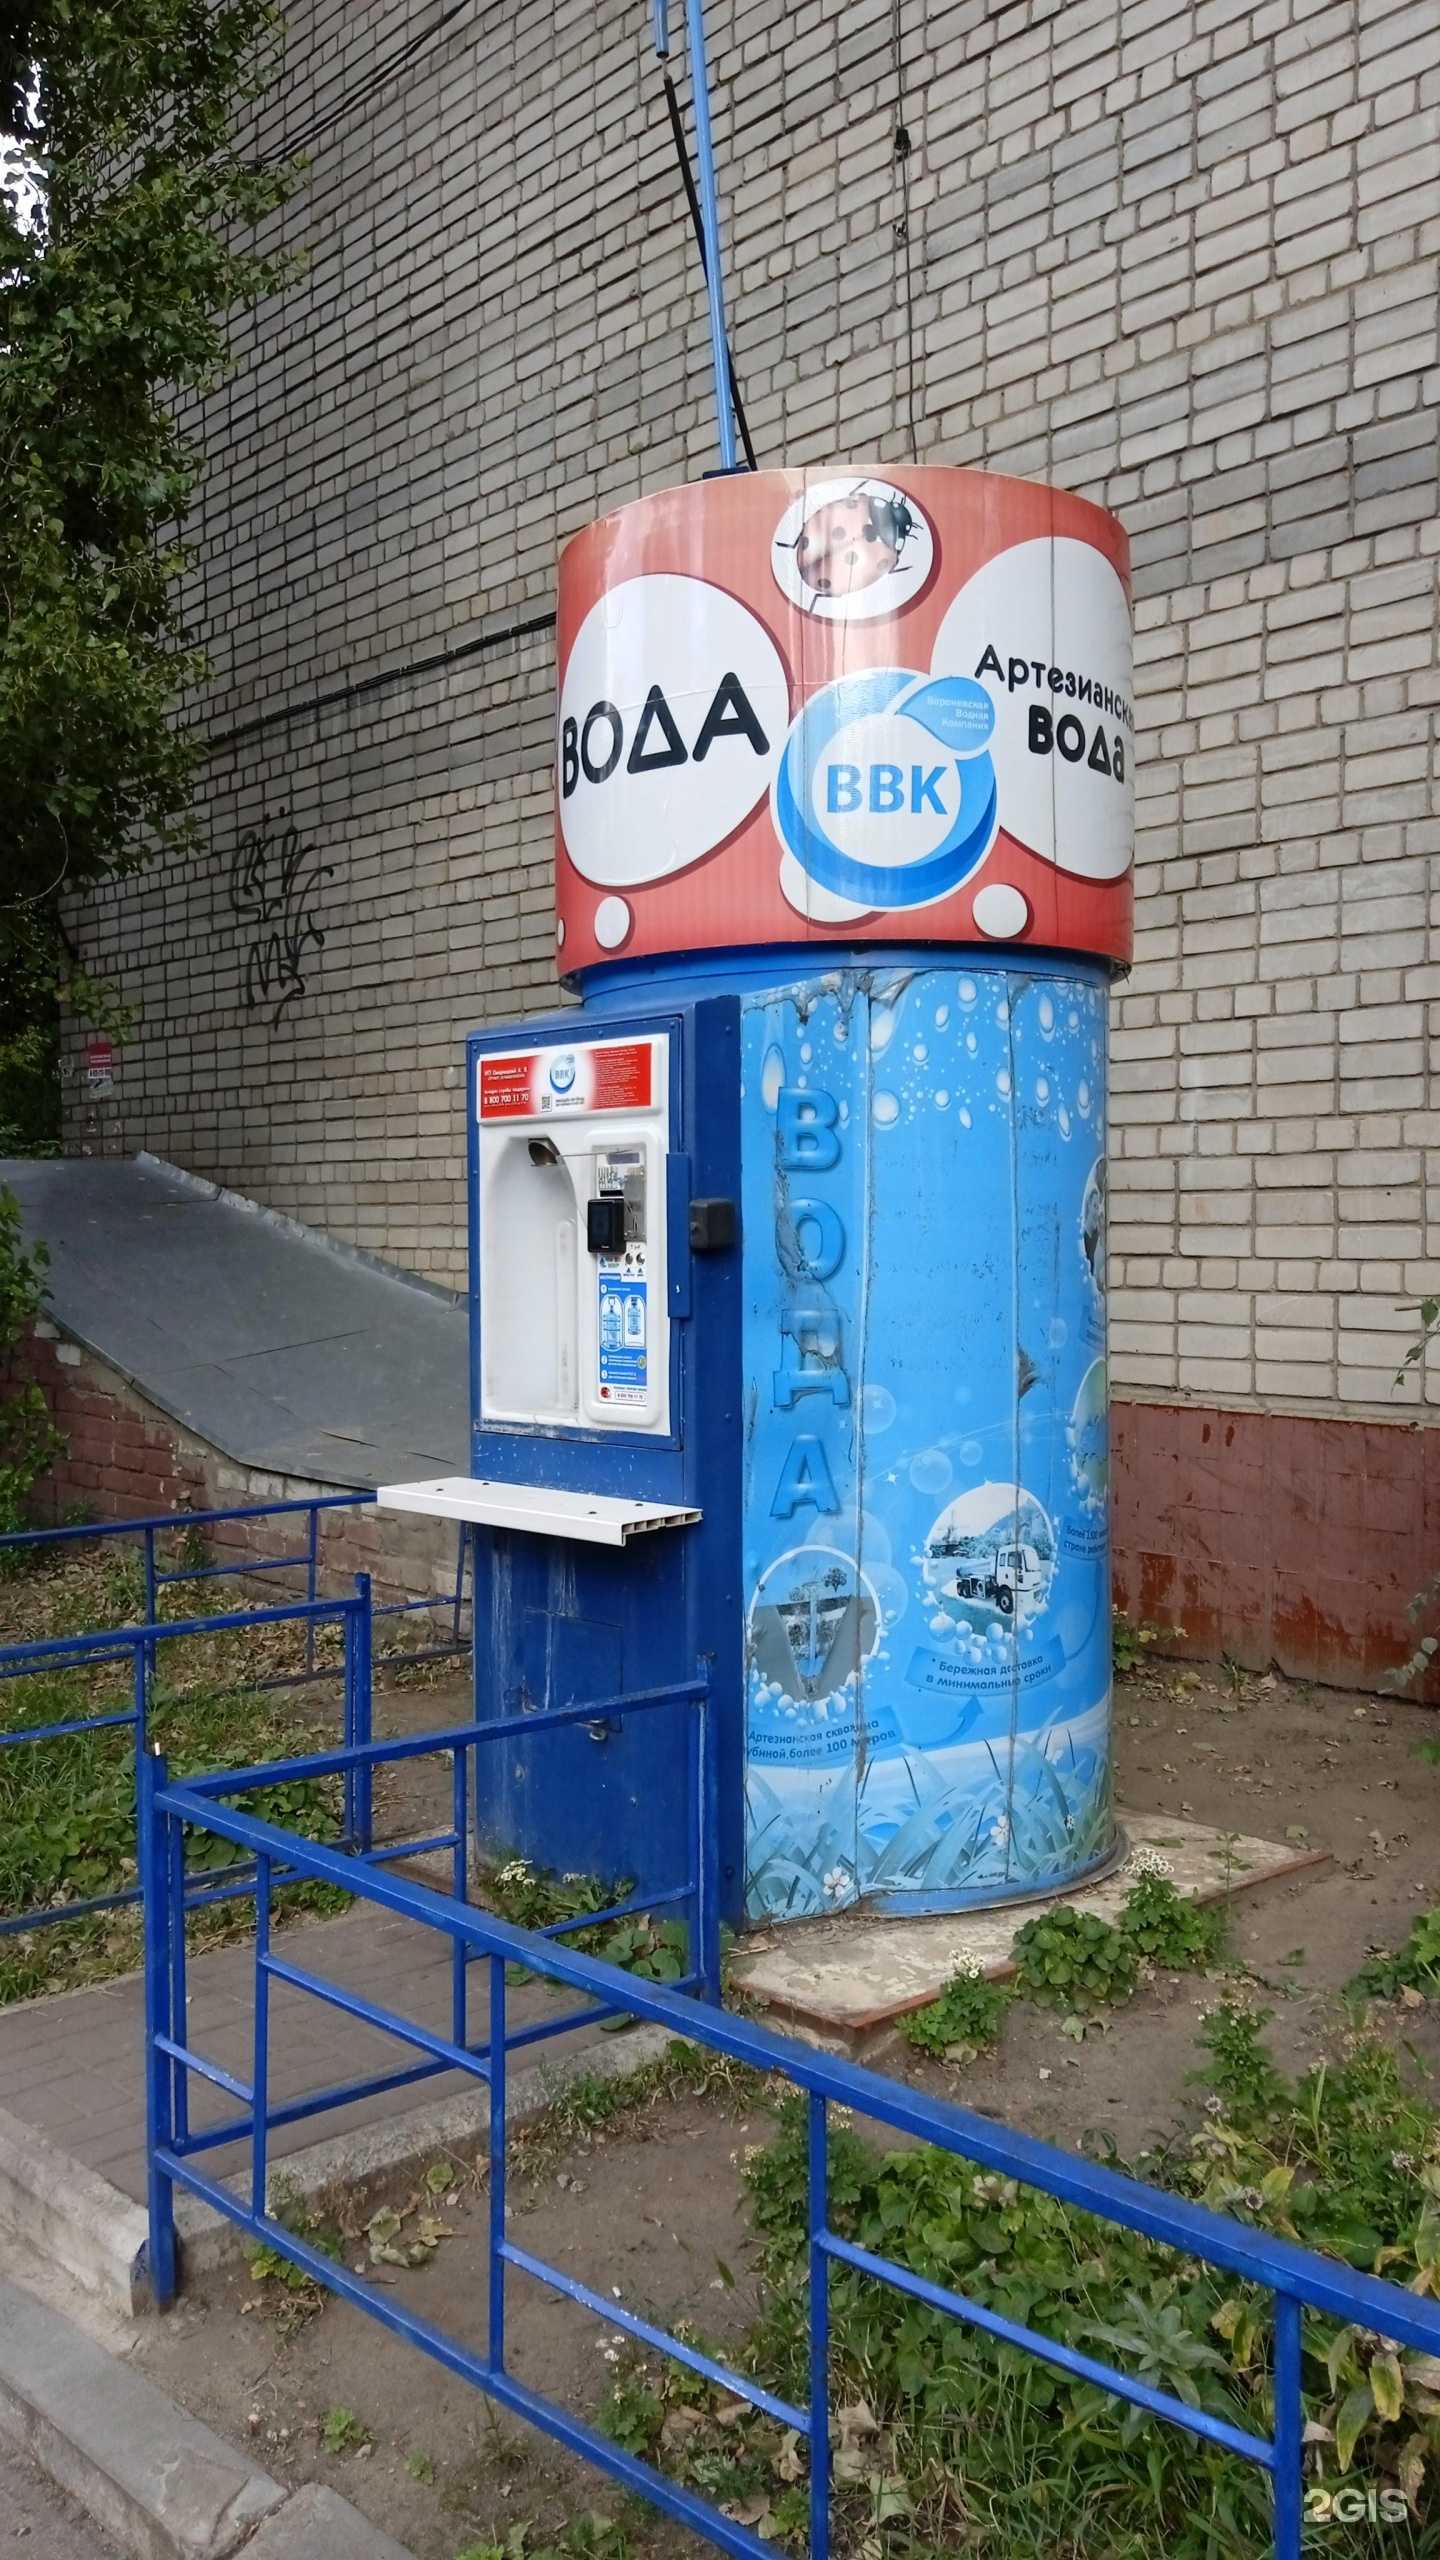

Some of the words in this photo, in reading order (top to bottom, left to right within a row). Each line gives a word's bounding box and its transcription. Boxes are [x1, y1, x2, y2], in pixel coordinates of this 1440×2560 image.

[974, 643, 1134, 730] Артезианск
[826, 763, 948, 816] ВВК
[939, 1660, 997, 1676] Бережная
[827, 1739, 848, 1754] 100
